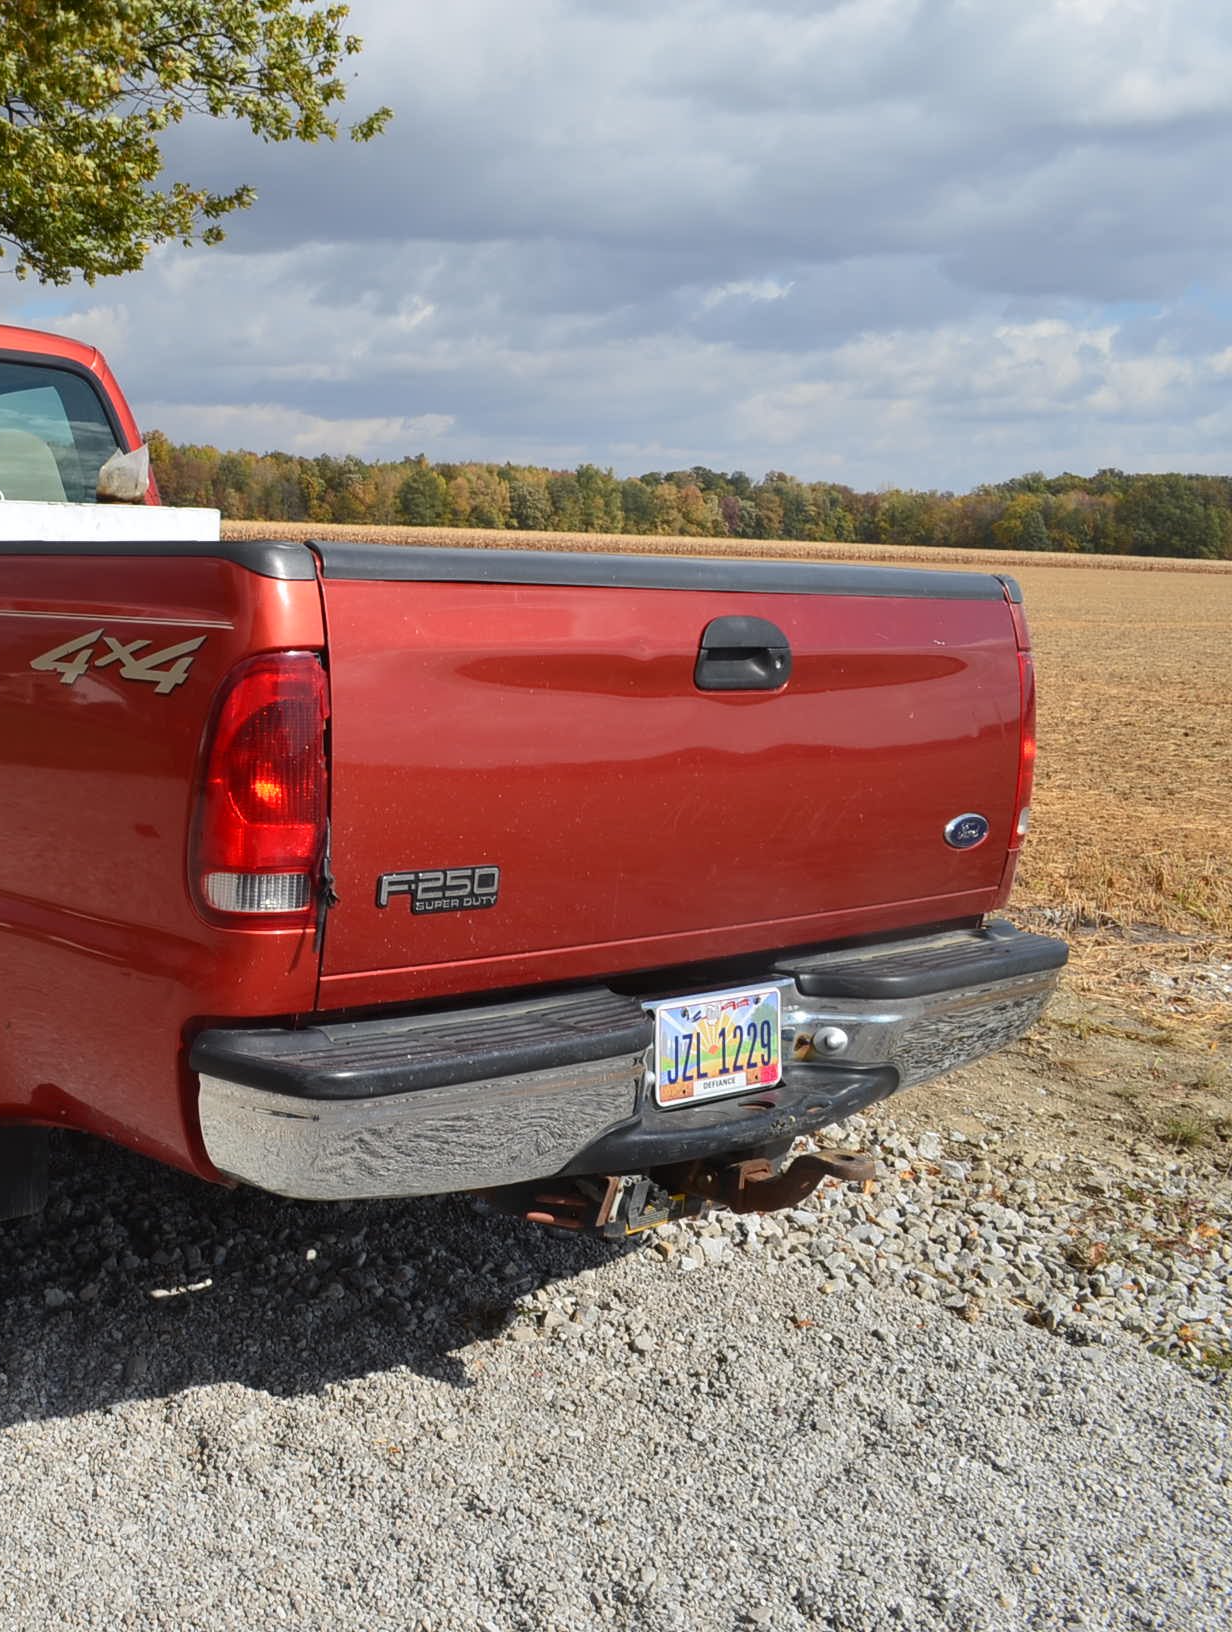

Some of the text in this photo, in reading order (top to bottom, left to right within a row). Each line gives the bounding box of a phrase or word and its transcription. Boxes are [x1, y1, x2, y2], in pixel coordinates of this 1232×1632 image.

[415, 895, 497, 911] SUPER DUTY
[667, 1020, 772, 1085] JZL 1229
[703, 1077, 736, 1090] DEFIANCE
